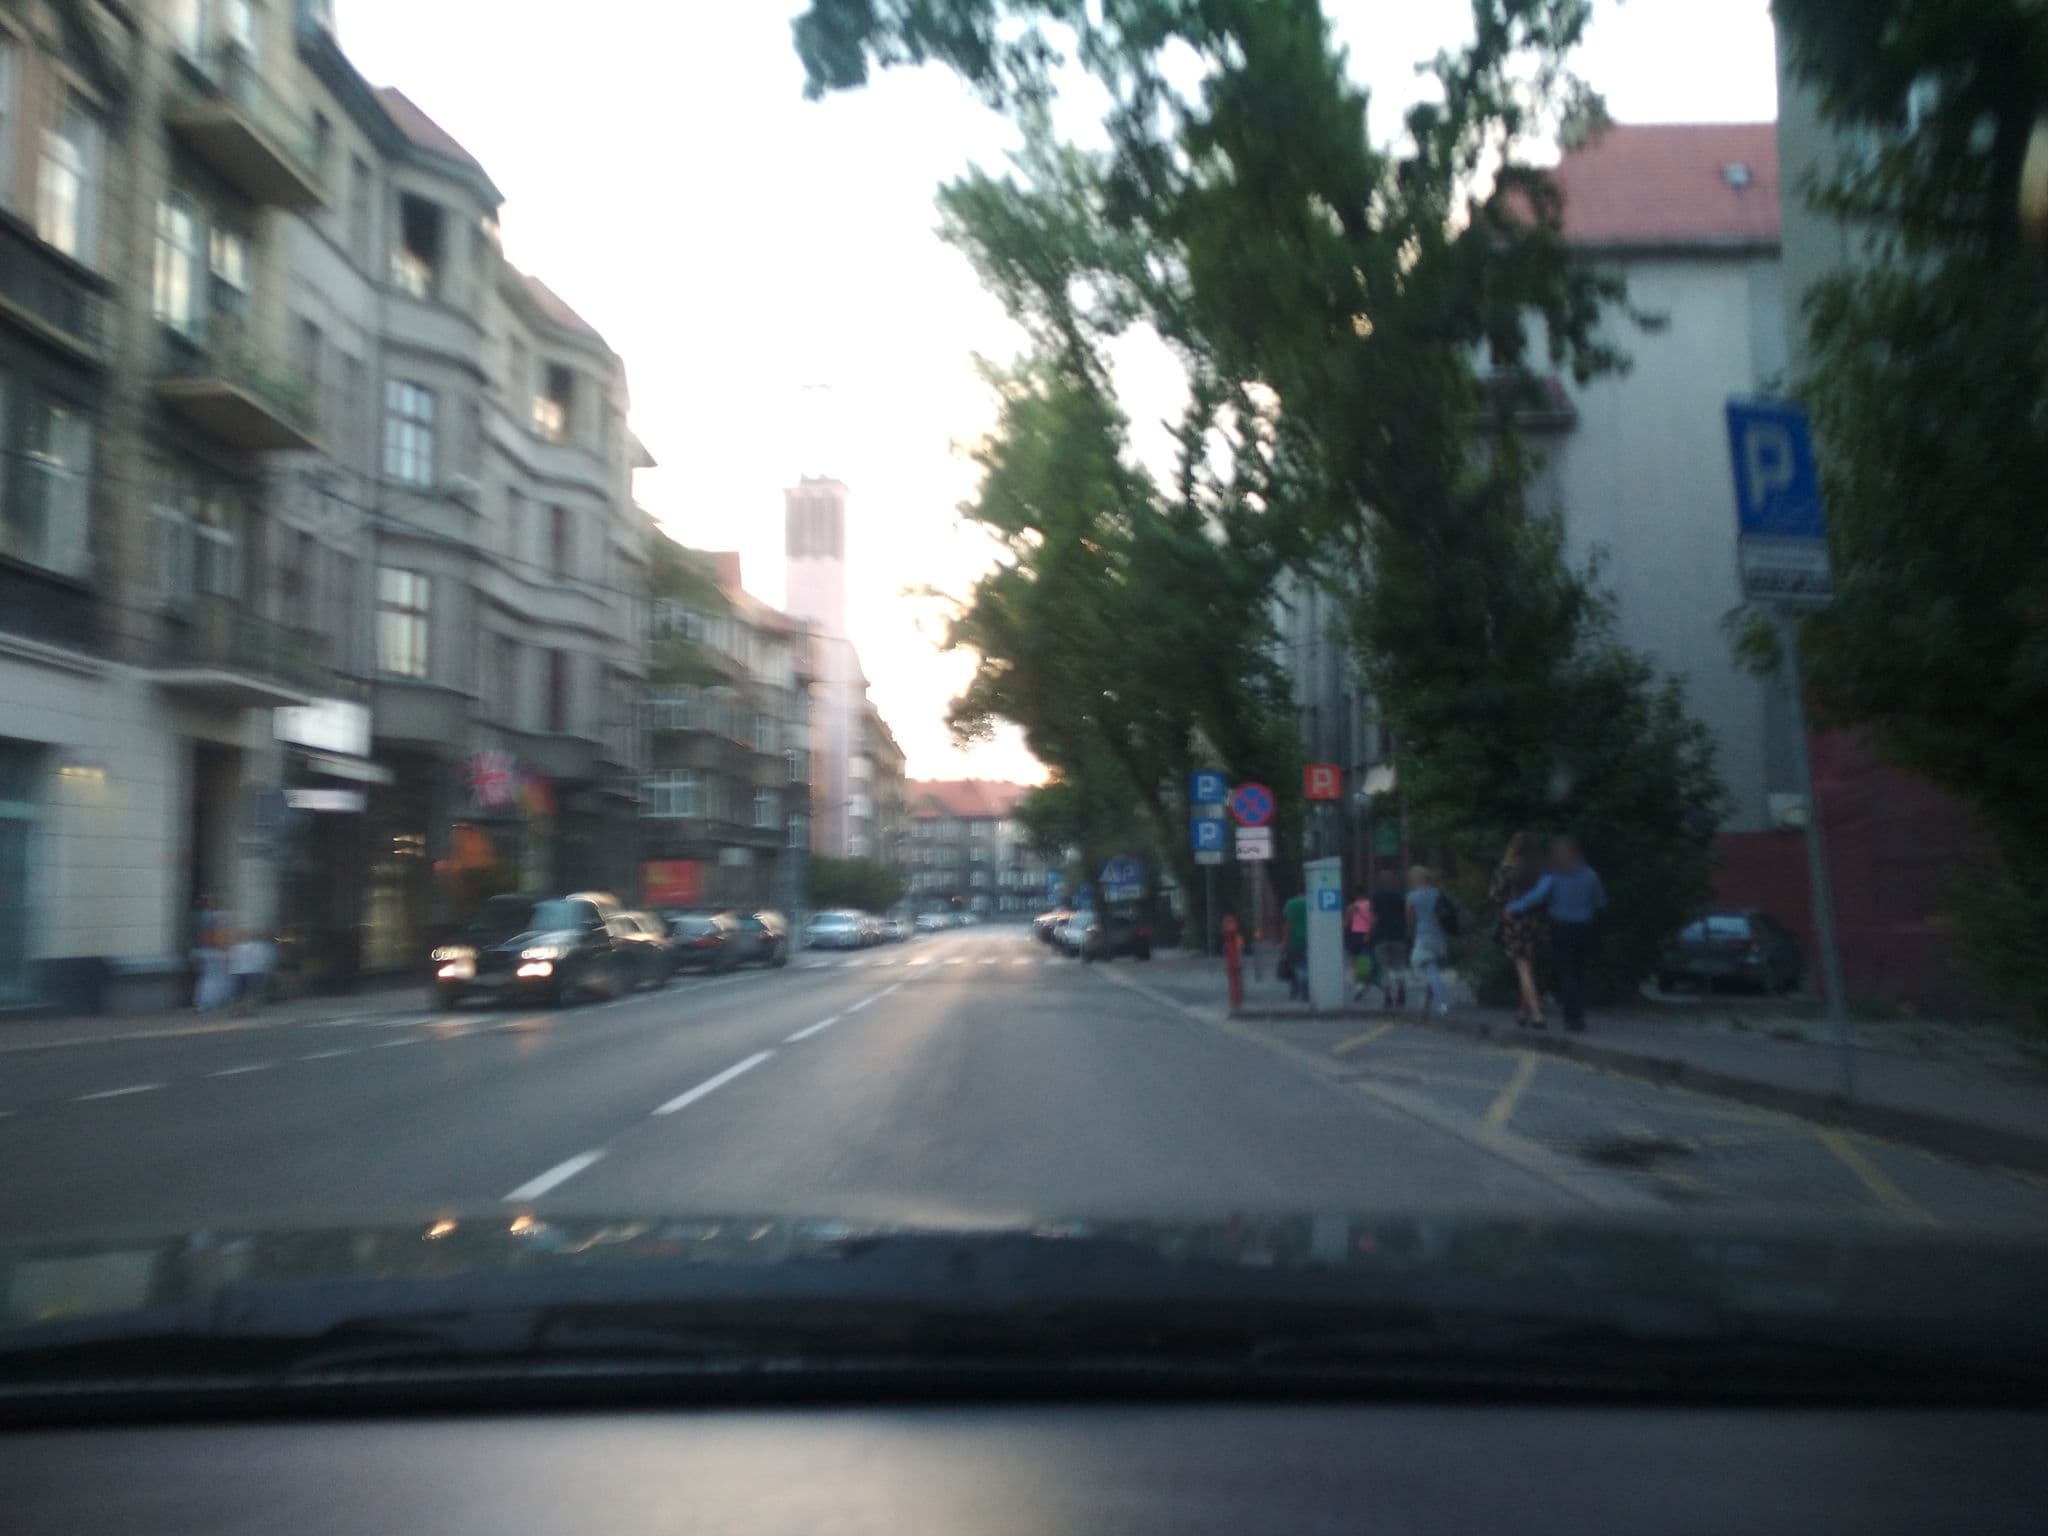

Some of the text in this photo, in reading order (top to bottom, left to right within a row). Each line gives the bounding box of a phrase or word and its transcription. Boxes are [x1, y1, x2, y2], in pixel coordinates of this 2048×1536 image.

[1747, 423, 1796, 511] P
[1197, 775, 1217, 799] P
[1312, 767, 1335, 796] R
[1198, 822, 1217, 848] P
[1323, 892, 1336, 909] P
